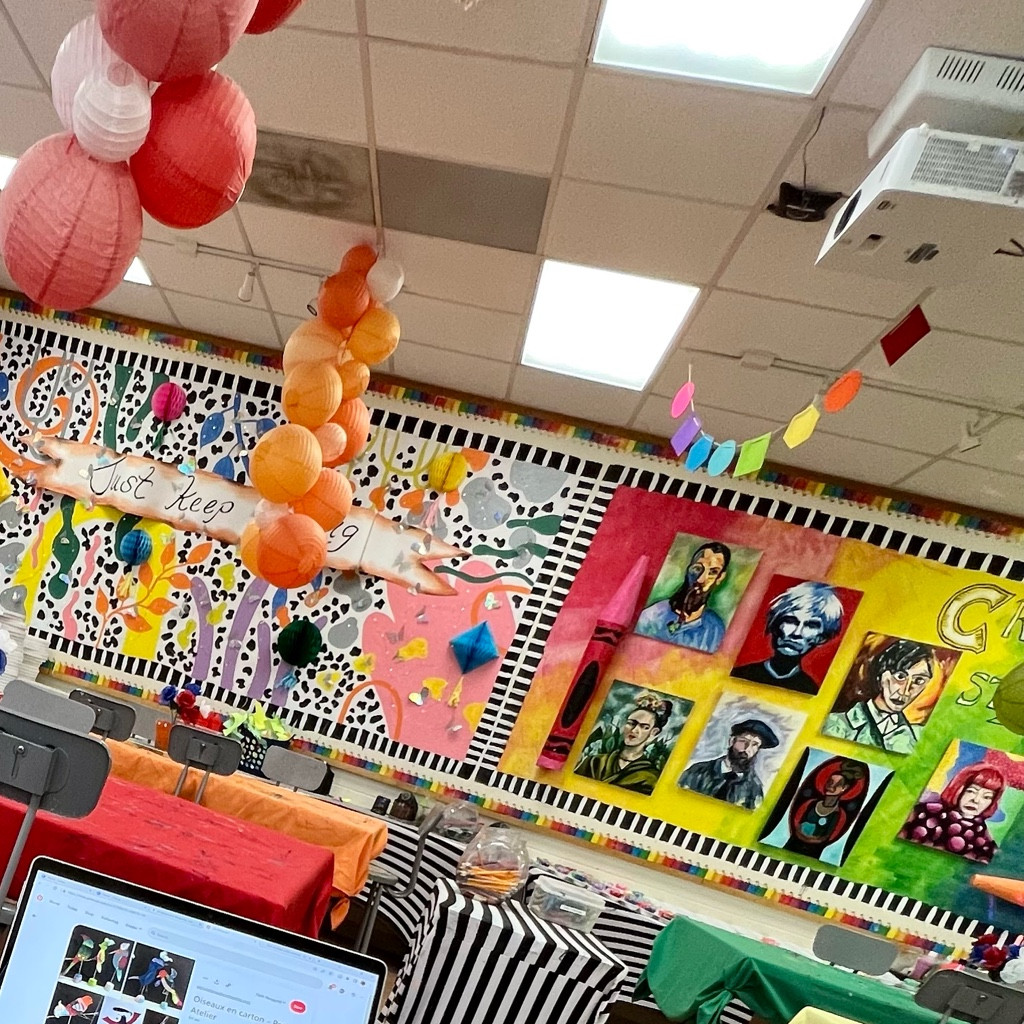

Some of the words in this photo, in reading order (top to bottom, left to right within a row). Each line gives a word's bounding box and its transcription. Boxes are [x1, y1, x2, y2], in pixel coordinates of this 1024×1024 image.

[88, 456, 156, 501] Just
[163, 475, 236, 524] Keep
[190, 1007, 217, 1021] Atelier
[193, 995, 225, 1011] Oiseaux
[226, 1006, 237, 1015] en
[238, 1010, 265, 1023] carton
